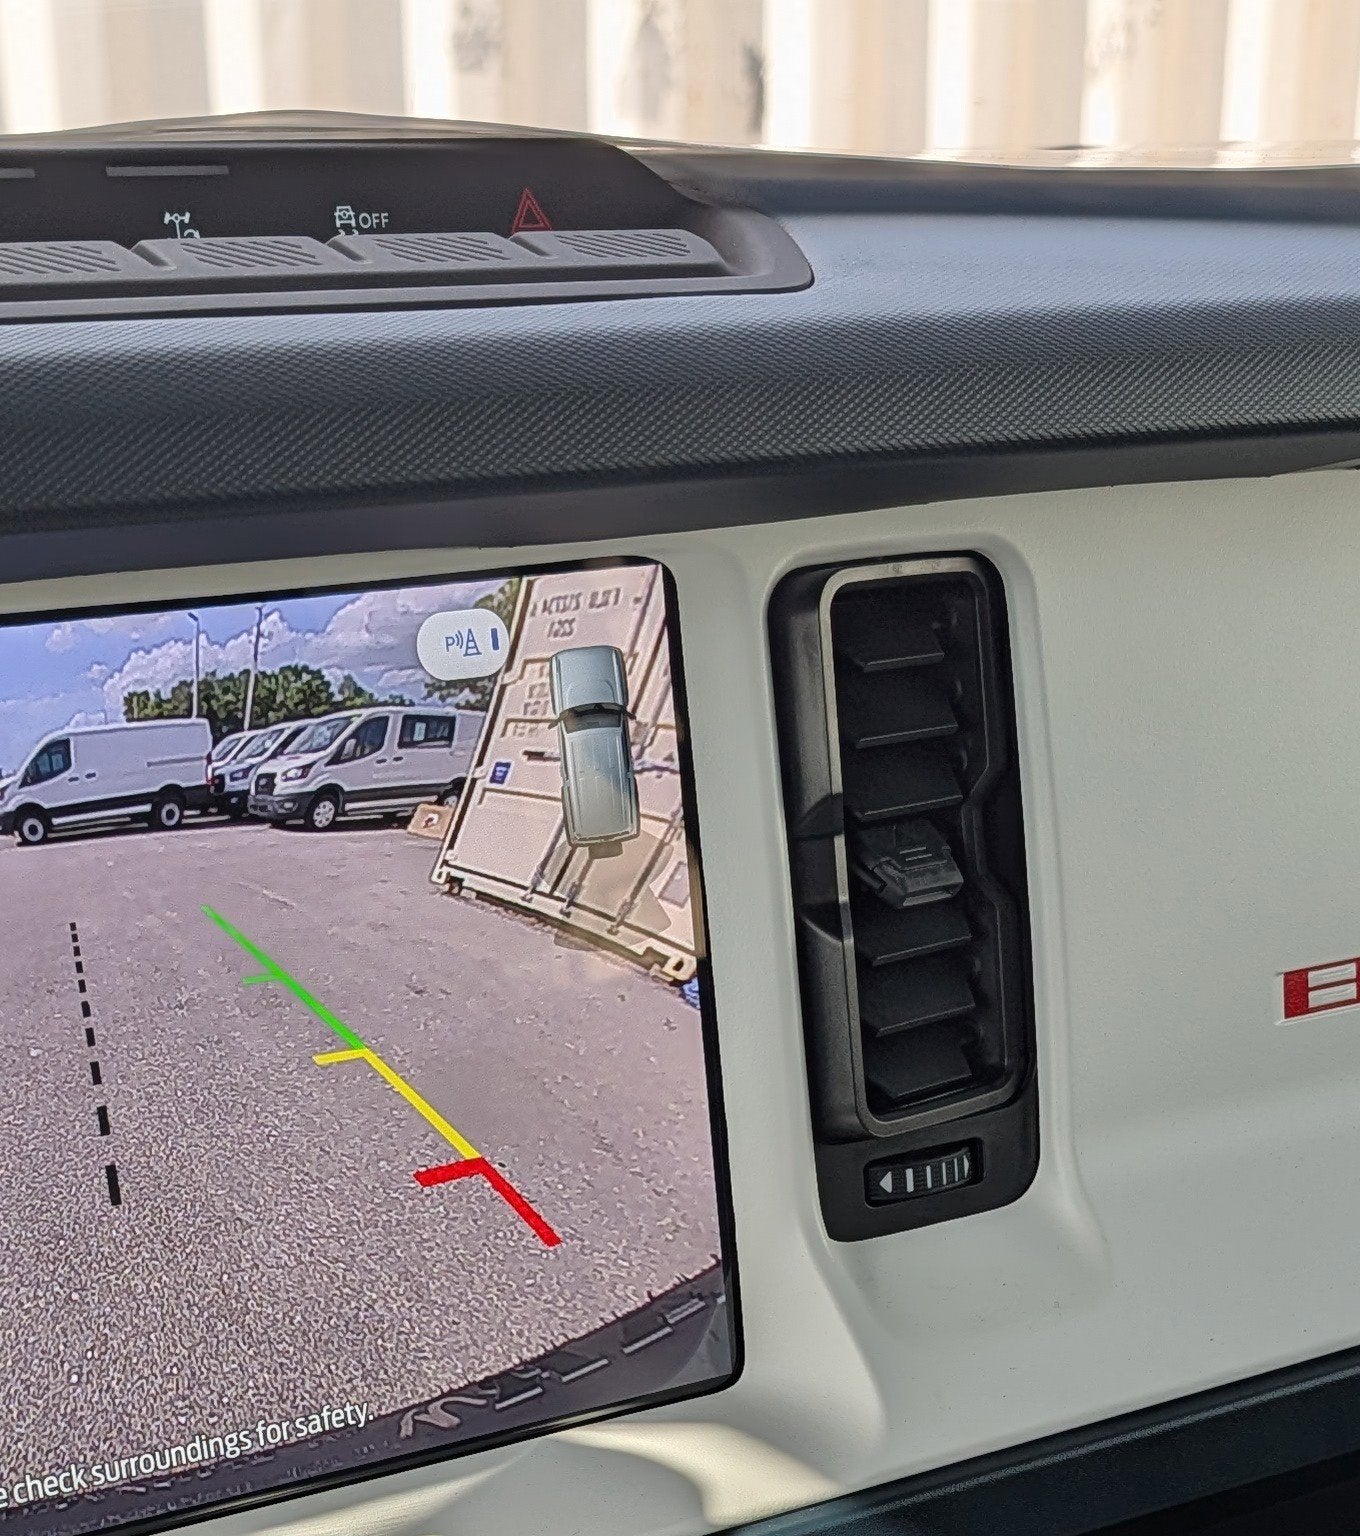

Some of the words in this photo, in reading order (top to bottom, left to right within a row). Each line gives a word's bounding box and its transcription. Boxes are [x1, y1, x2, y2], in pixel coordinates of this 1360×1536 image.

[359, 212, 389, 229] OFF
[13, 1466, 86, 1504] check
[90, 1431, 251, 1491] surroundings
[255, 1421, 292, 1447] for
[295, 1401, 375, 1437] safety.
